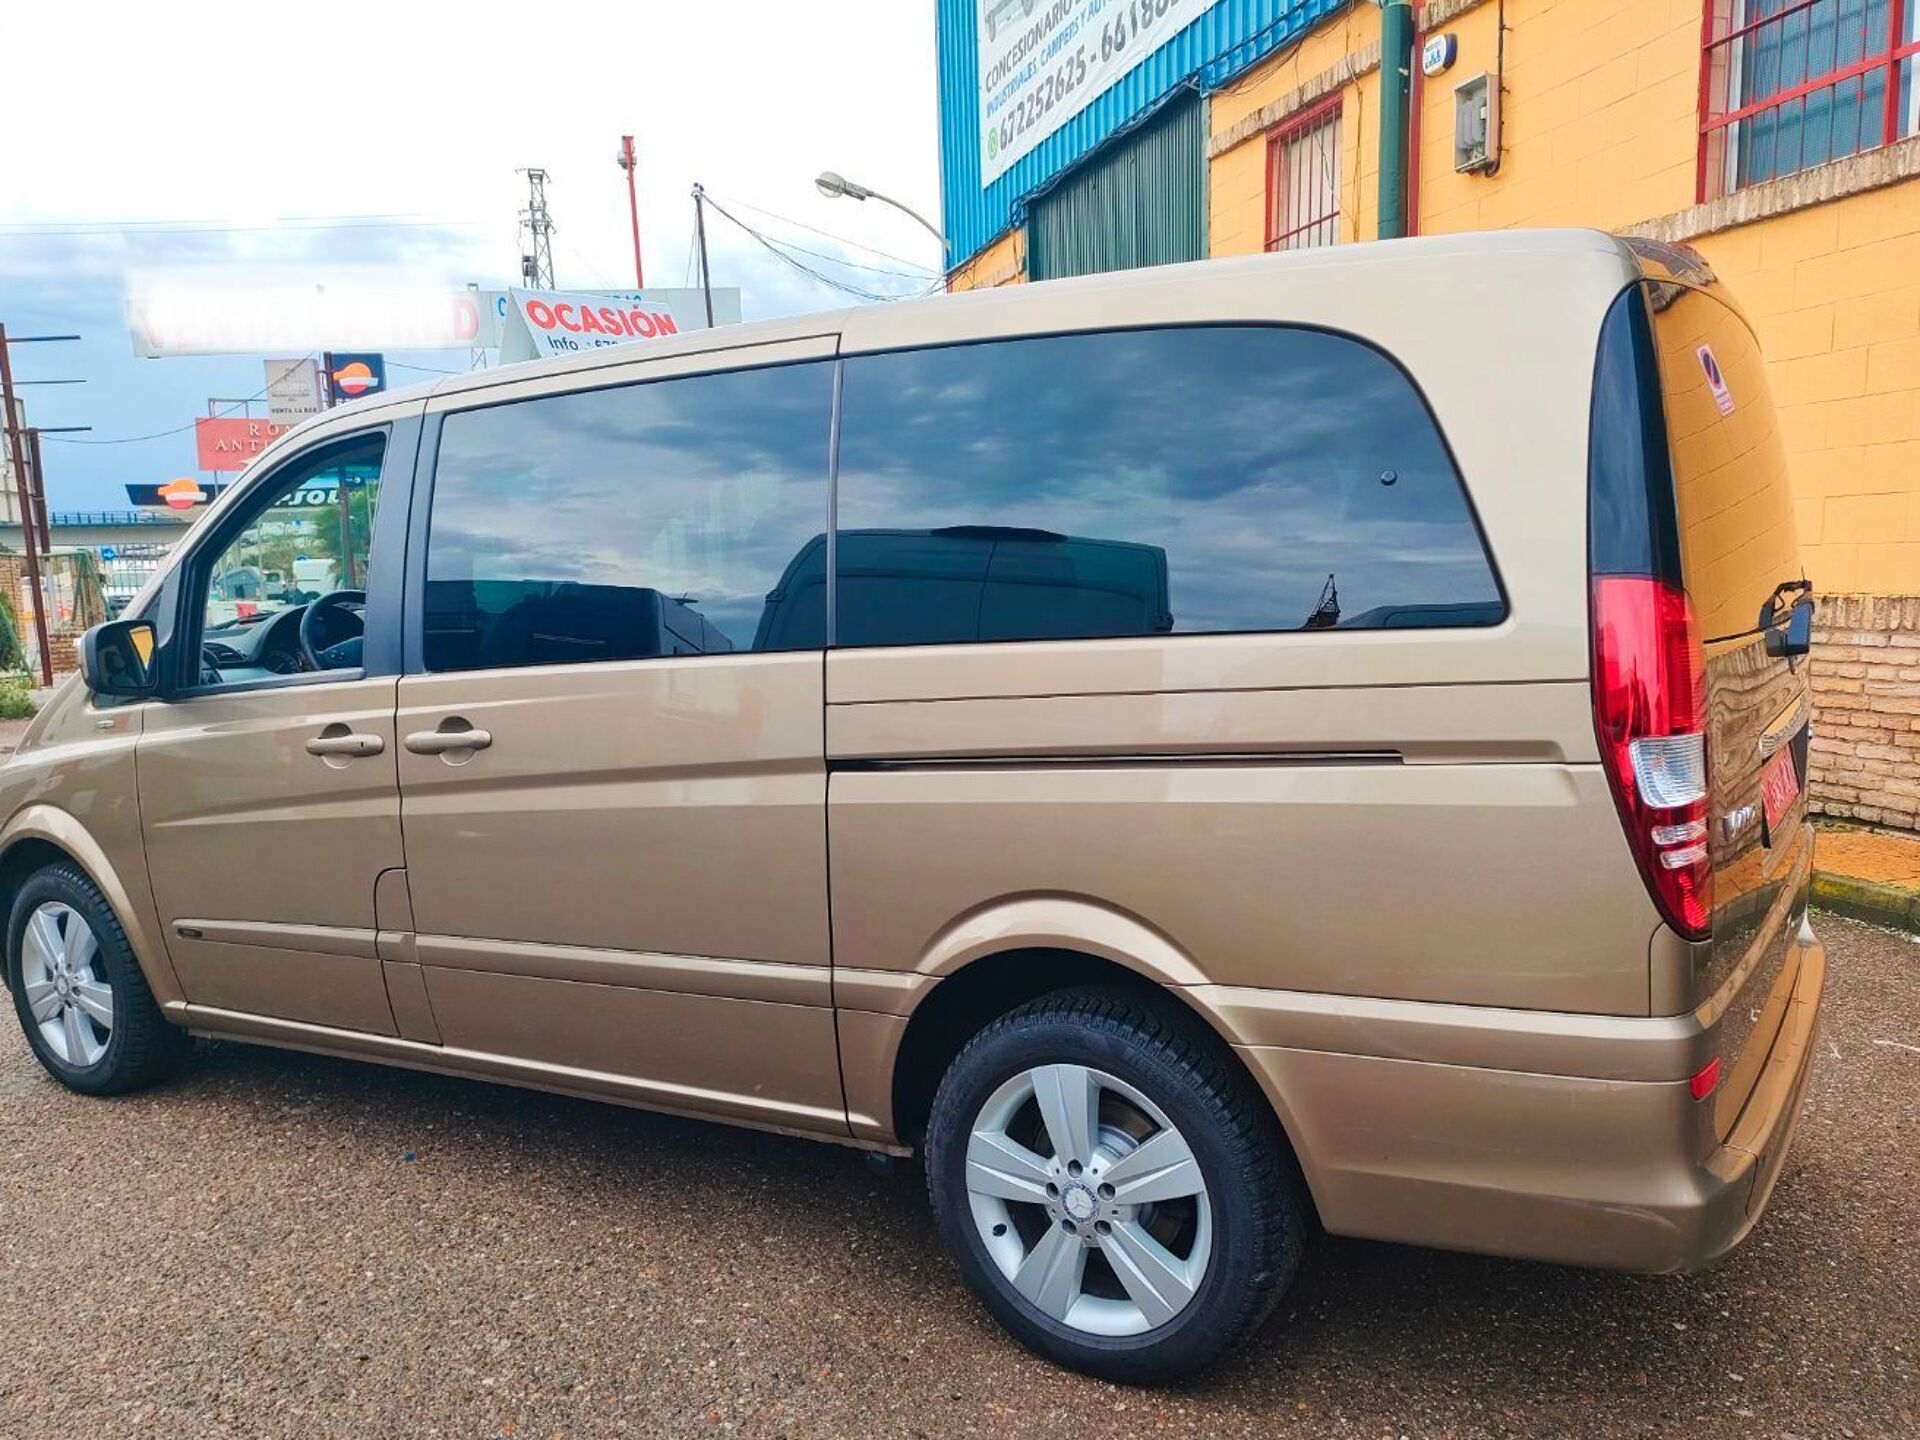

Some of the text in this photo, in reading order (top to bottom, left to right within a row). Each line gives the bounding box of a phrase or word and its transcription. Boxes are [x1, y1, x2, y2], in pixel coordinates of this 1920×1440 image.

[986, 0, 1072, 93] CONCESIONARIO
[1001, 44, 1087, 151] 672252625
[526, 299, 678, 338] OCASIÓN
[546, 335, 579, 351] Info
